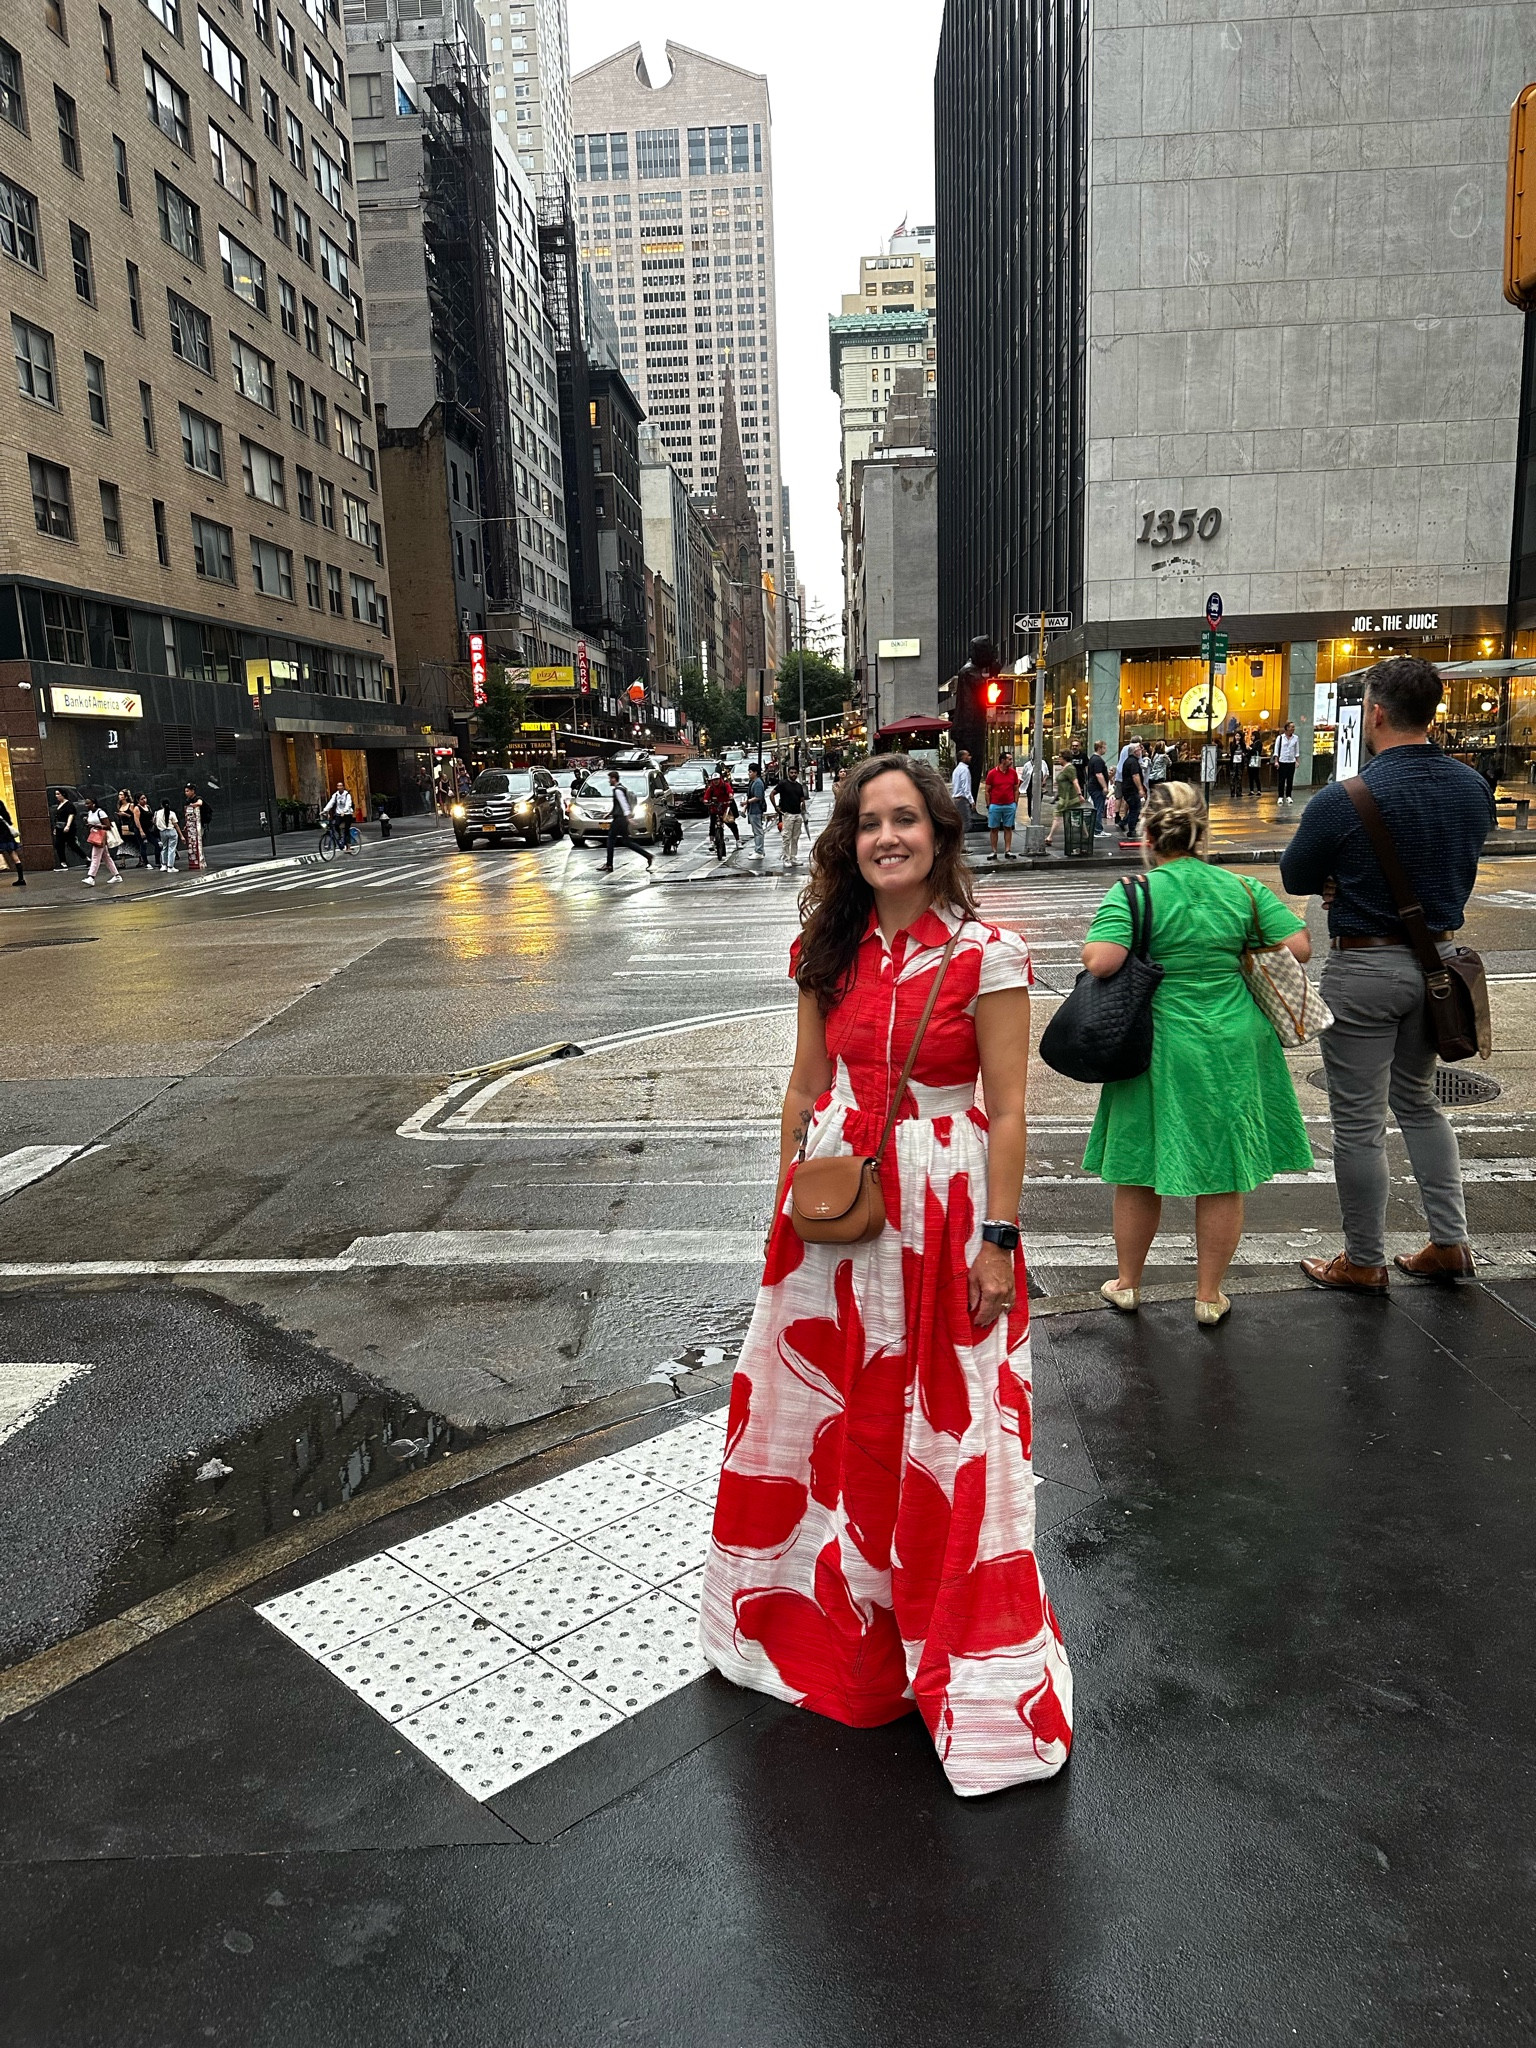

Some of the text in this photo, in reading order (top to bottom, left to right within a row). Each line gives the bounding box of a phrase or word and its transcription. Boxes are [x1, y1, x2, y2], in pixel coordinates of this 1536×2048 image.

[1137, 507, 1222, 547] 1350
[1021, 618, 1067, 628] ONE WAY
[1351, 616, 1373, 632] JOE
[1381, 615, 1403, 631] THE
[1405, 613, 1439, 630] JUICE
[579, 652, 588, 684] PARK
[64, 694, 120, 710] Bank of America
